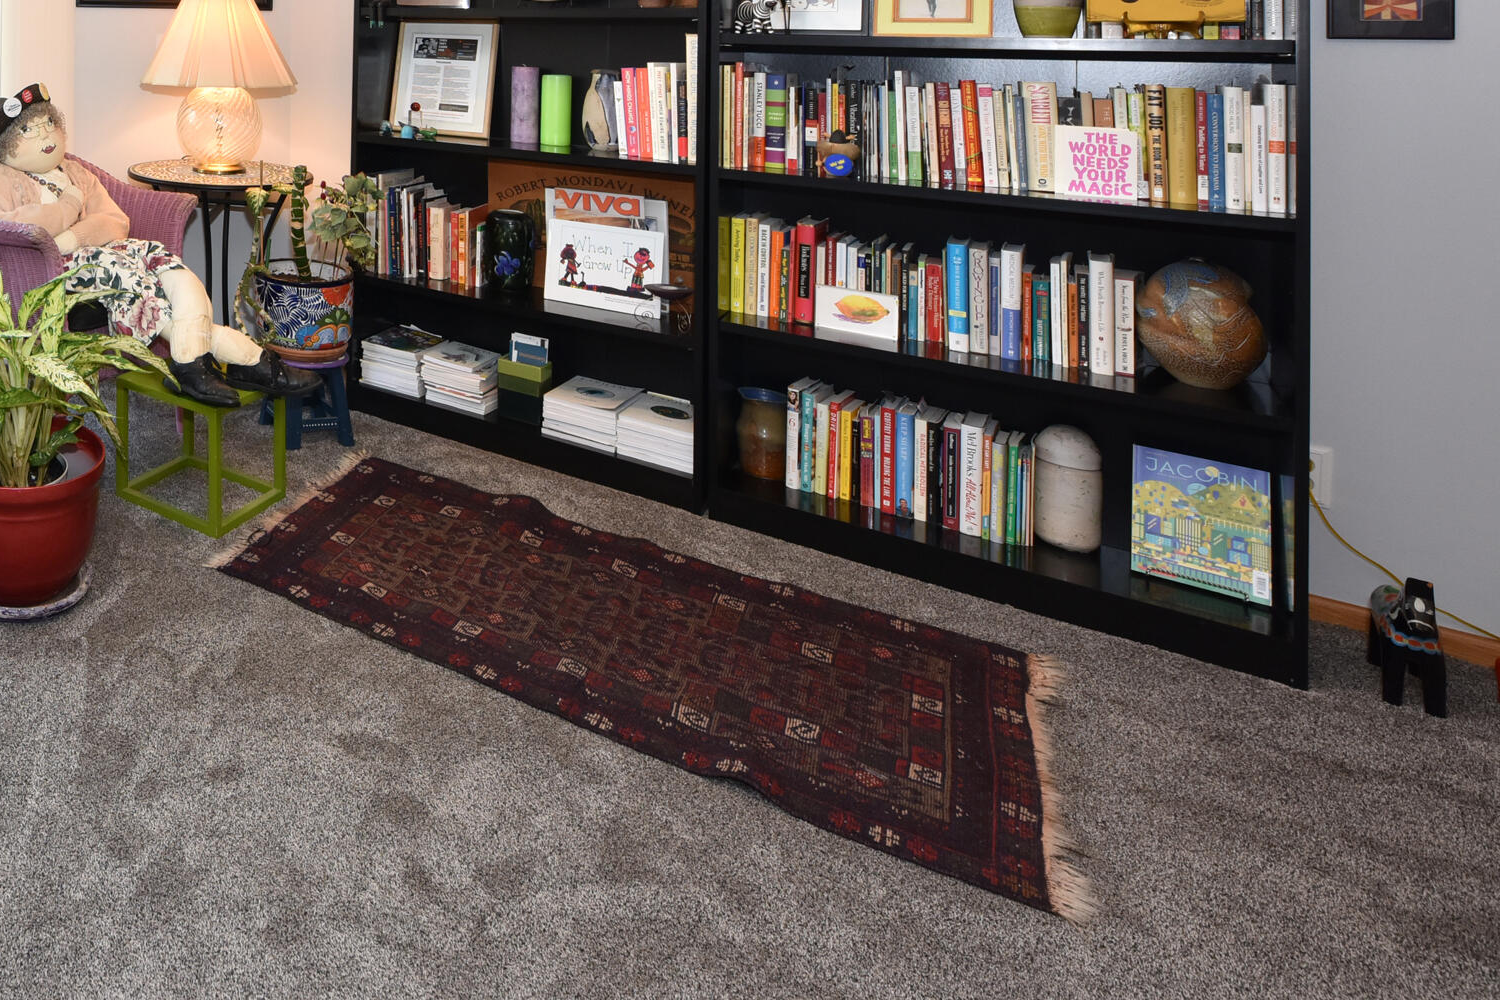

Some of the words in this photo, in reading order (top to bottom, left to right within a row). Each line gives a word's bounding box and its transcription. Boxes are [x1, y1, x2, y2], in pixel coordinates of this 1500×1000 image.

[1027, 85, 1051, 125] SCARLETT
[1148, 89, 1162, 108] FAT
[1100, 106, 1110, 121] THE
[1148, 112, 1163, 131] JOE
[1084, 132, 1118, 144] THE
[1152, 134, 1161, 145] THE
[1211, 111, 1219, 152] CONVERSION
[1068, 141, 1132, 157] WORLD
[1153, 147, 1162, 161] BOOK
[1212, 154, 1219, 163] TO
[1073, 154, 1129, 169] NEEDS
[1074, 166, 1126, 182] YOUR
[1212, 163, 1220, 191] JUDAISM
[496, 178, 548, 202] ROBERT
[554, 175, 634, 193] MONDAVI
[572, 234, 612, 256] When
[733, 229, 741, 248] Arriving
[583, 255, 612, 271] Grow
[733, 248, 741, 263] Today
[829, 412, 837, 432] DRIVE
[883, 412, 892, 434] GEOFFREY
[900, 417, 908, 436] KEEP
[900, 437, 908, 460] SHARP
[966, 432, 977, 447] Mel
[883, 457, 891, 476] HOLDING
[966, 447, 977, 477] Brooks
[883, 477, 891, 485] THE
[965, 477, 977, 489] All
[1146, 456, 1258, 492] JACOBIN
[883, 486, 891, 497] LINE
[965, 489, 977, 510] About
[965, 509, 979, 526] Me!
